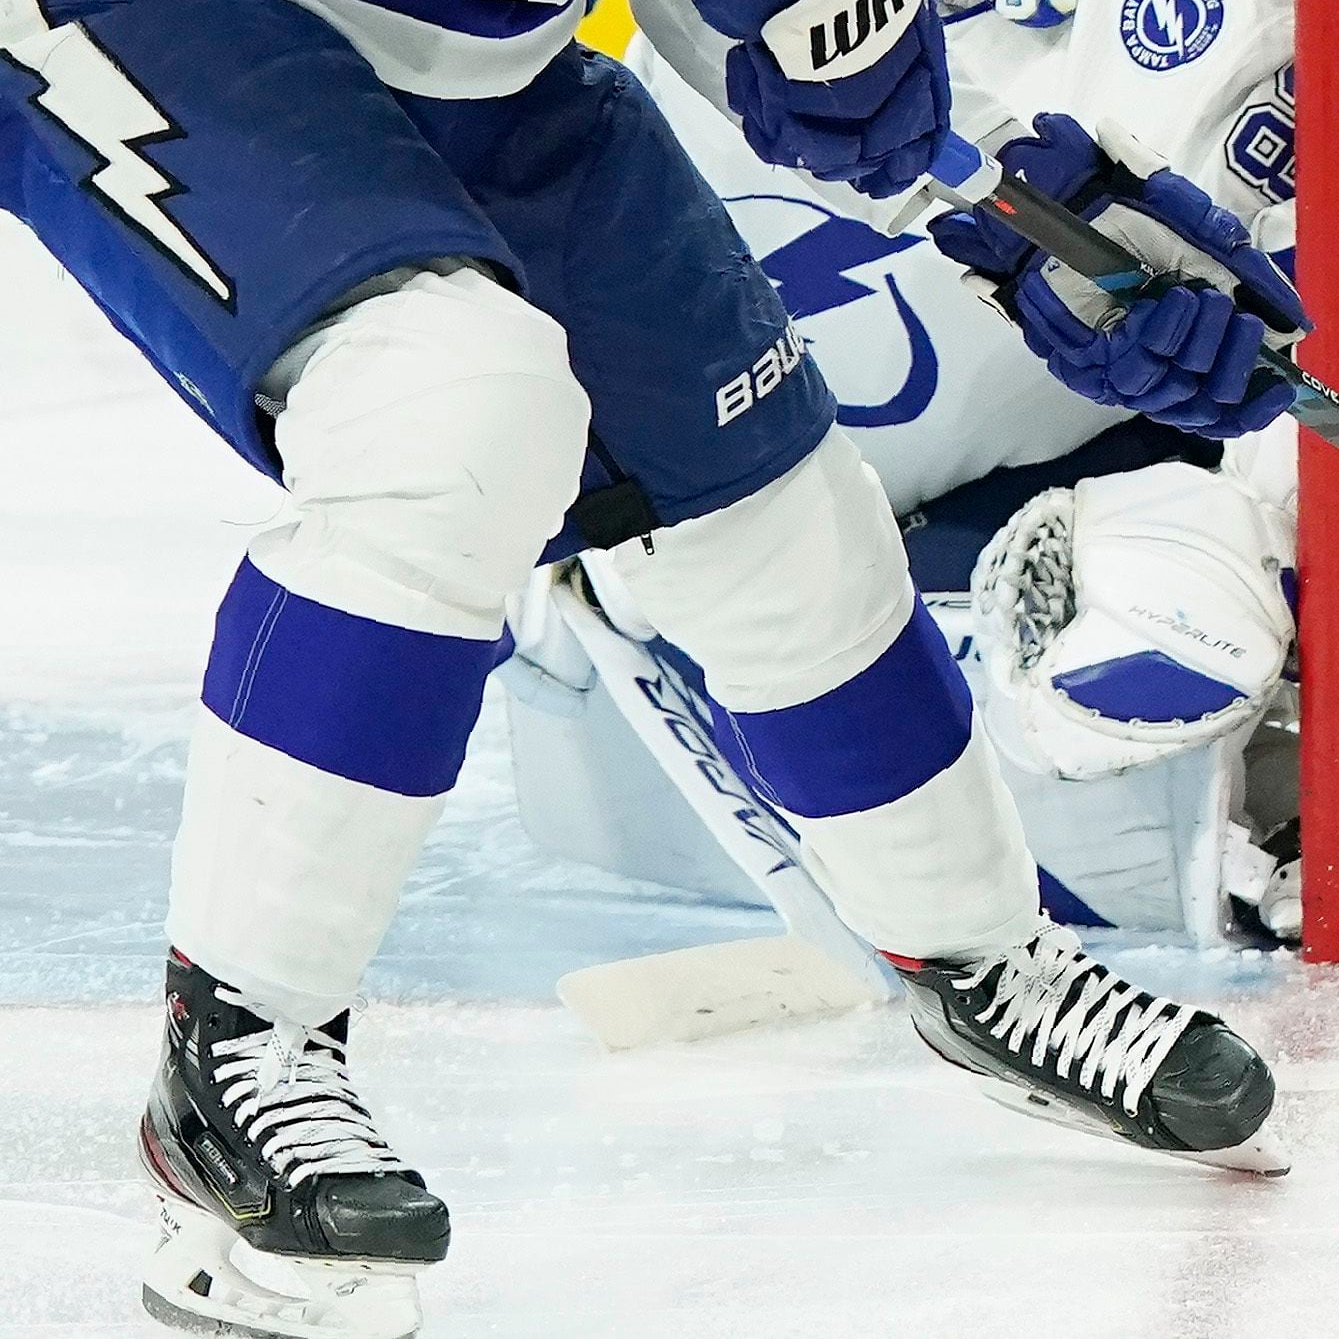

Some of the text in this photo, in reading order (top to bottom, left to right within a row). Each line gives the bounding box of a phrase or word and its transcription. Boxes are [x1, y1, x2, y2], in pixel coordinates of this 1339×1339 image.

[1126, 34, 1169, 67] TAMPA
[1129, 605, 1248, 658] HYPERLITE
[634, 676, 798, 875] VAPOR
